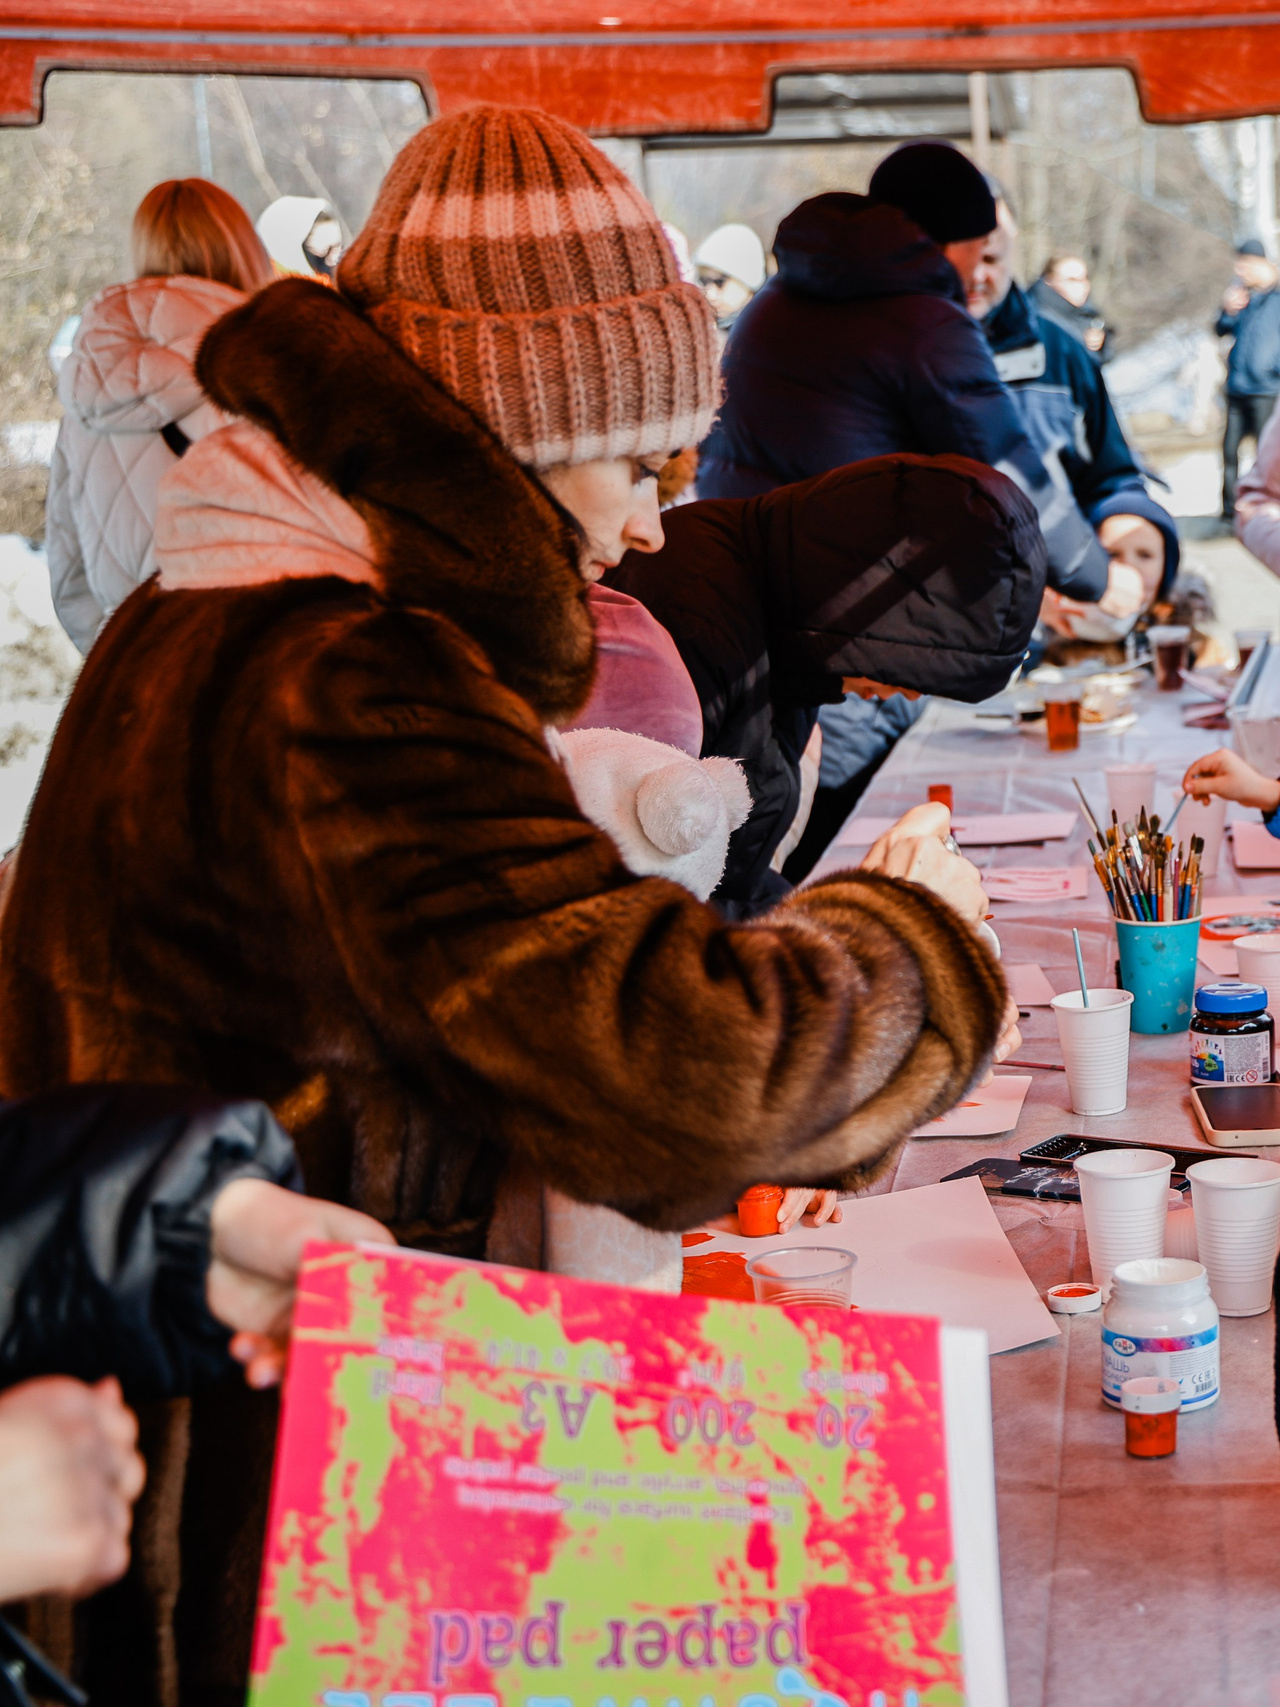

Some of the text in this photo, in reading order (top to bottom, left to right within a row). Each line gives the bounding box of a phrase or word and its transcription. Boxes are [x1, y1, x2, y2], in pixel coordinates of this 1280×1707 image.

[801, 1369, 887, 1396] sheets
[521, 1381, 594, 1439] A3
[666, 1396, 755, 1446] 200
[816, 1404, 874, 1449] 20
[432, 1601, 806, 1685] paper pad
